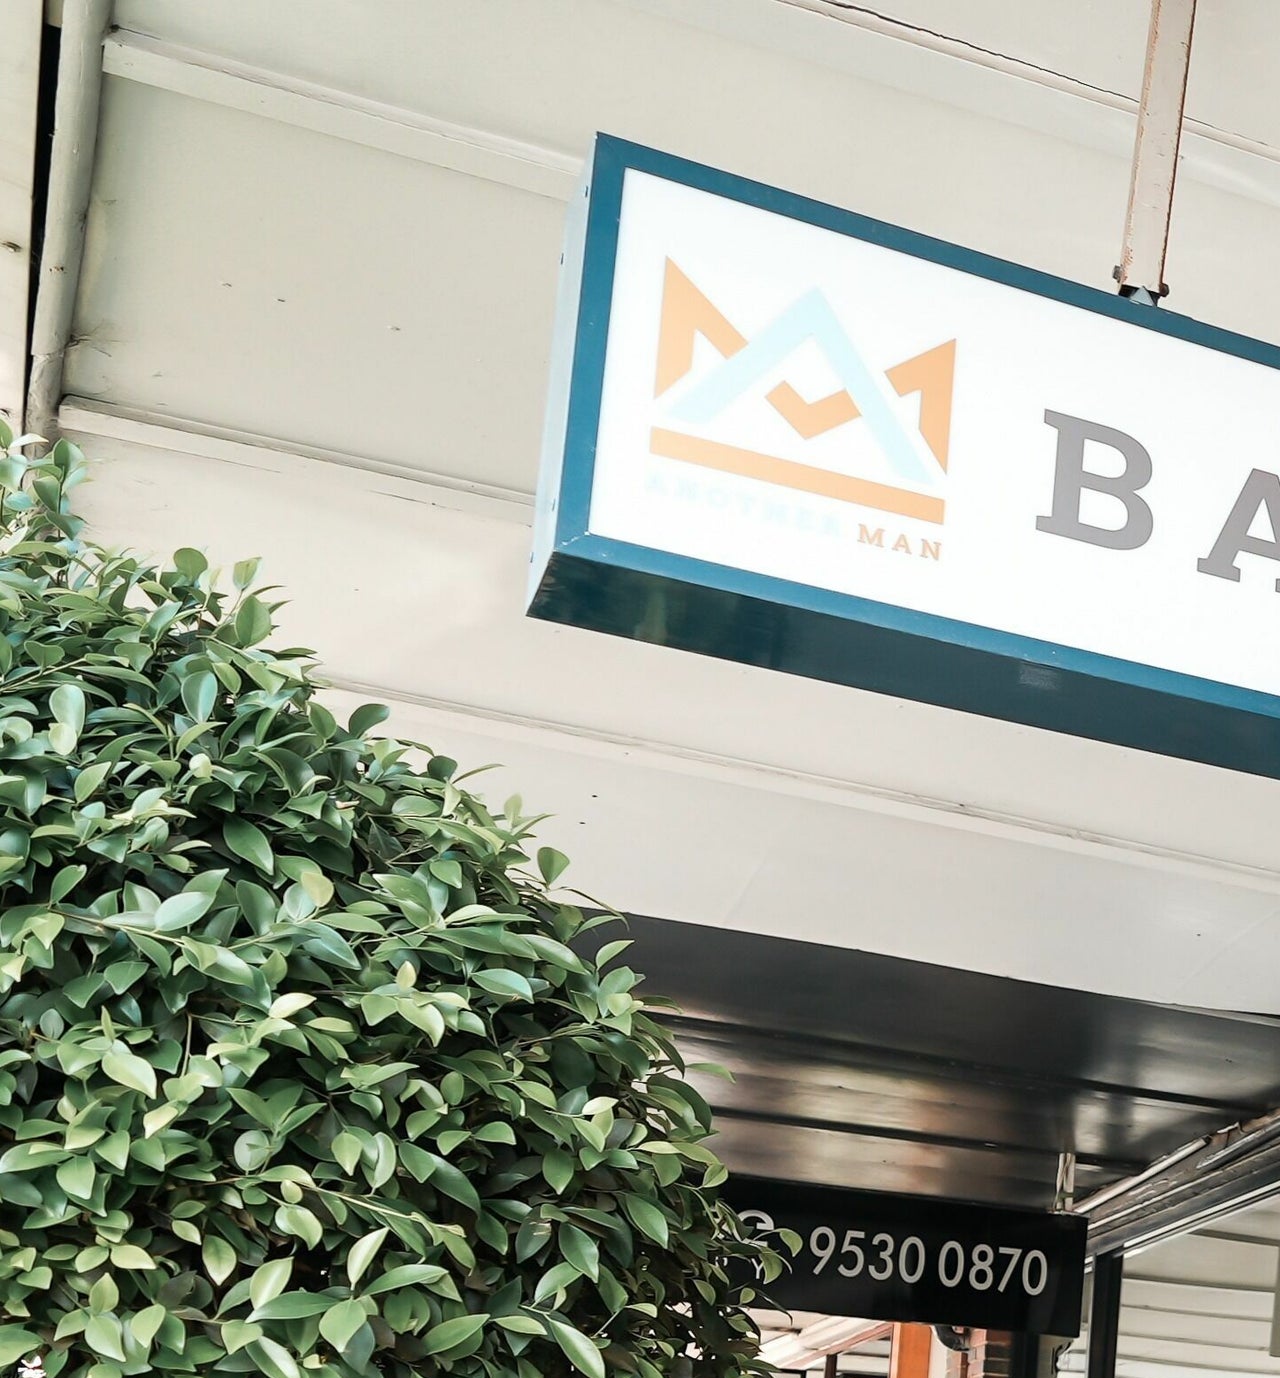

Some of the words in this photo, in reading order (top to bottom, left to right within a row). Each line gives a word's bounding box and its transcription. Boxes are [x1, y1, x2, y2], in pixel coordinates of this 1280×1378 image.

[857, 523, 942, 561] MAN
[809, 1226, 926, 1284] 9530
[938, 1240, 1048, 1296] 0870
